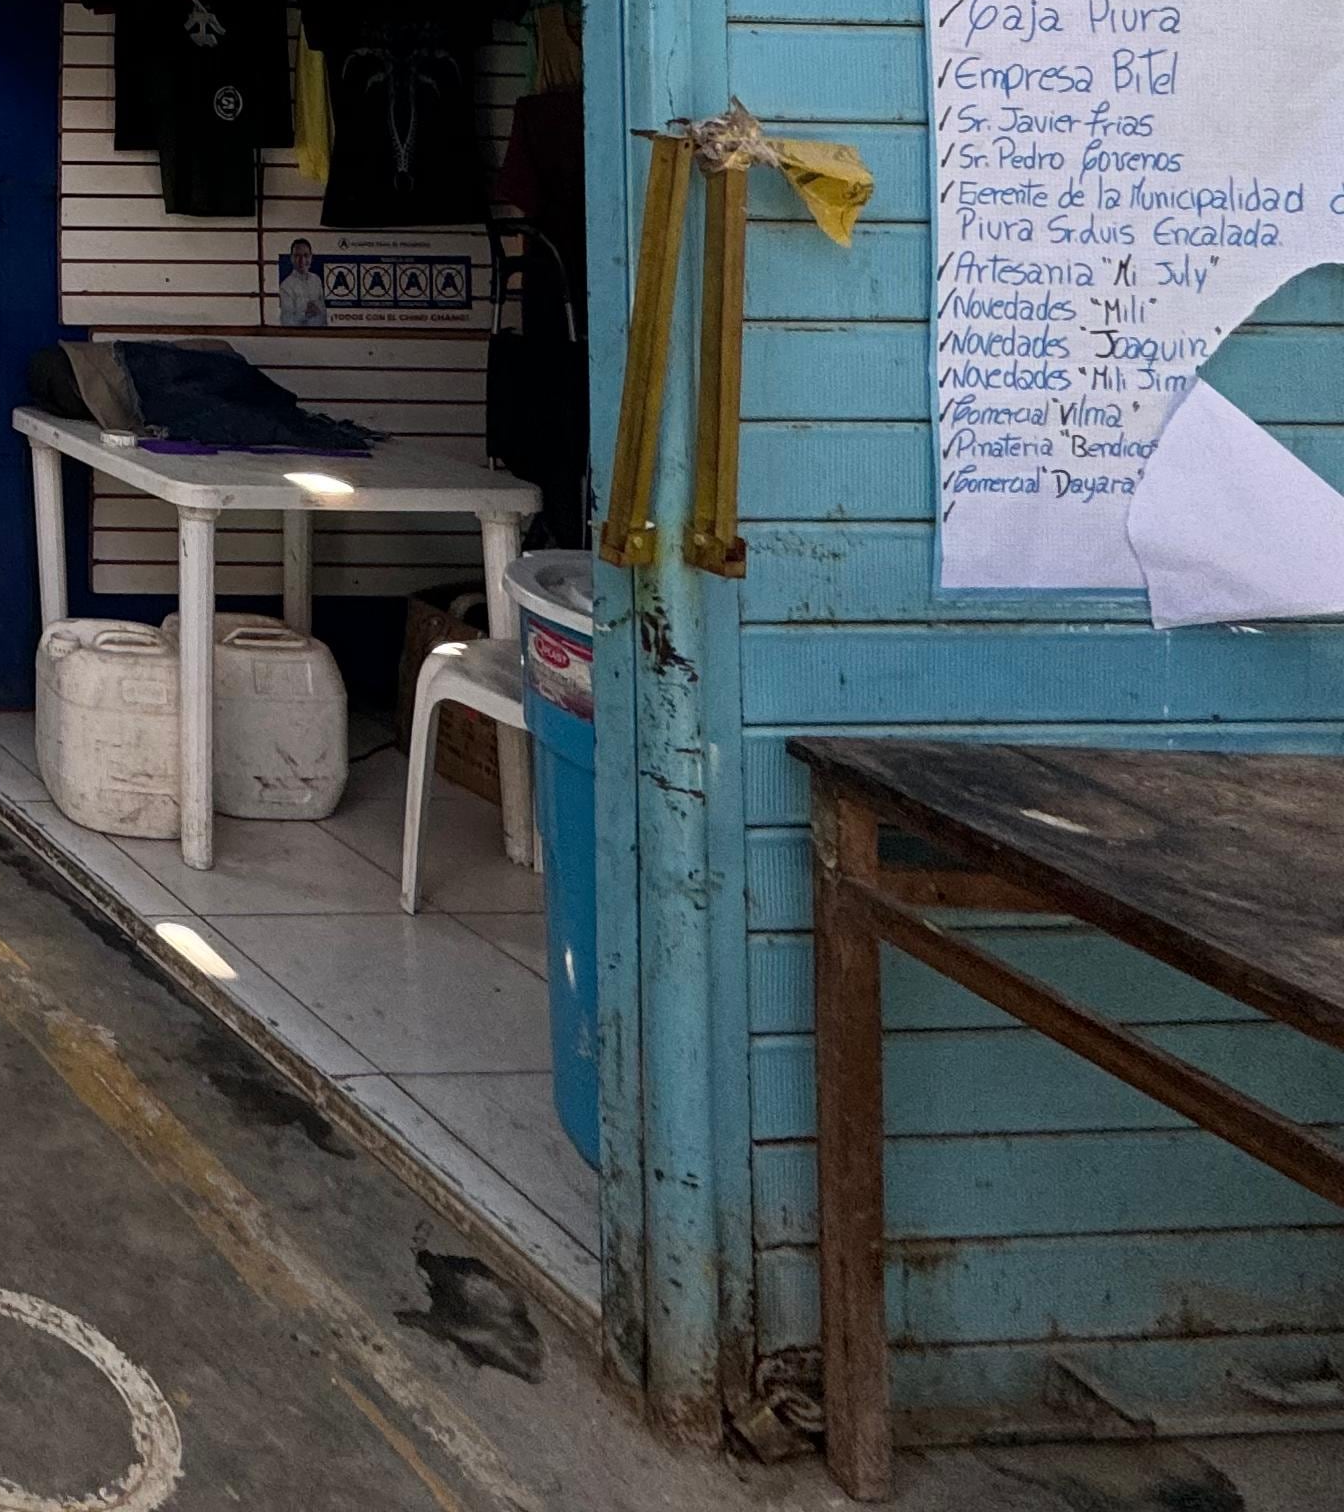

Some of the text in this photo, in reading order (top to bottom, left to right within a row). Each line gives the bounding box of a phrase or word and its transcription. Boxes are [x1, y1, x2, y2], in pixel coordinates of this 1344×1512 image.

[955, 48, 1178, 99] Empresa Bitel
[999, 106, 1082, 133] Javier
[992, 136, 1065, 170] Pedro
[1057, 176, 1085, 209] de
[1097, 176, 1121, 210] la
[1130, 176, 1304, 218] Municipalidad
[955, 206, 1034, 242] Piura
[953, 288, 1077, 322] Novedades
[952, 324, 1071, 359] Novedades
[952, 359, 1073, 391] Novedades
